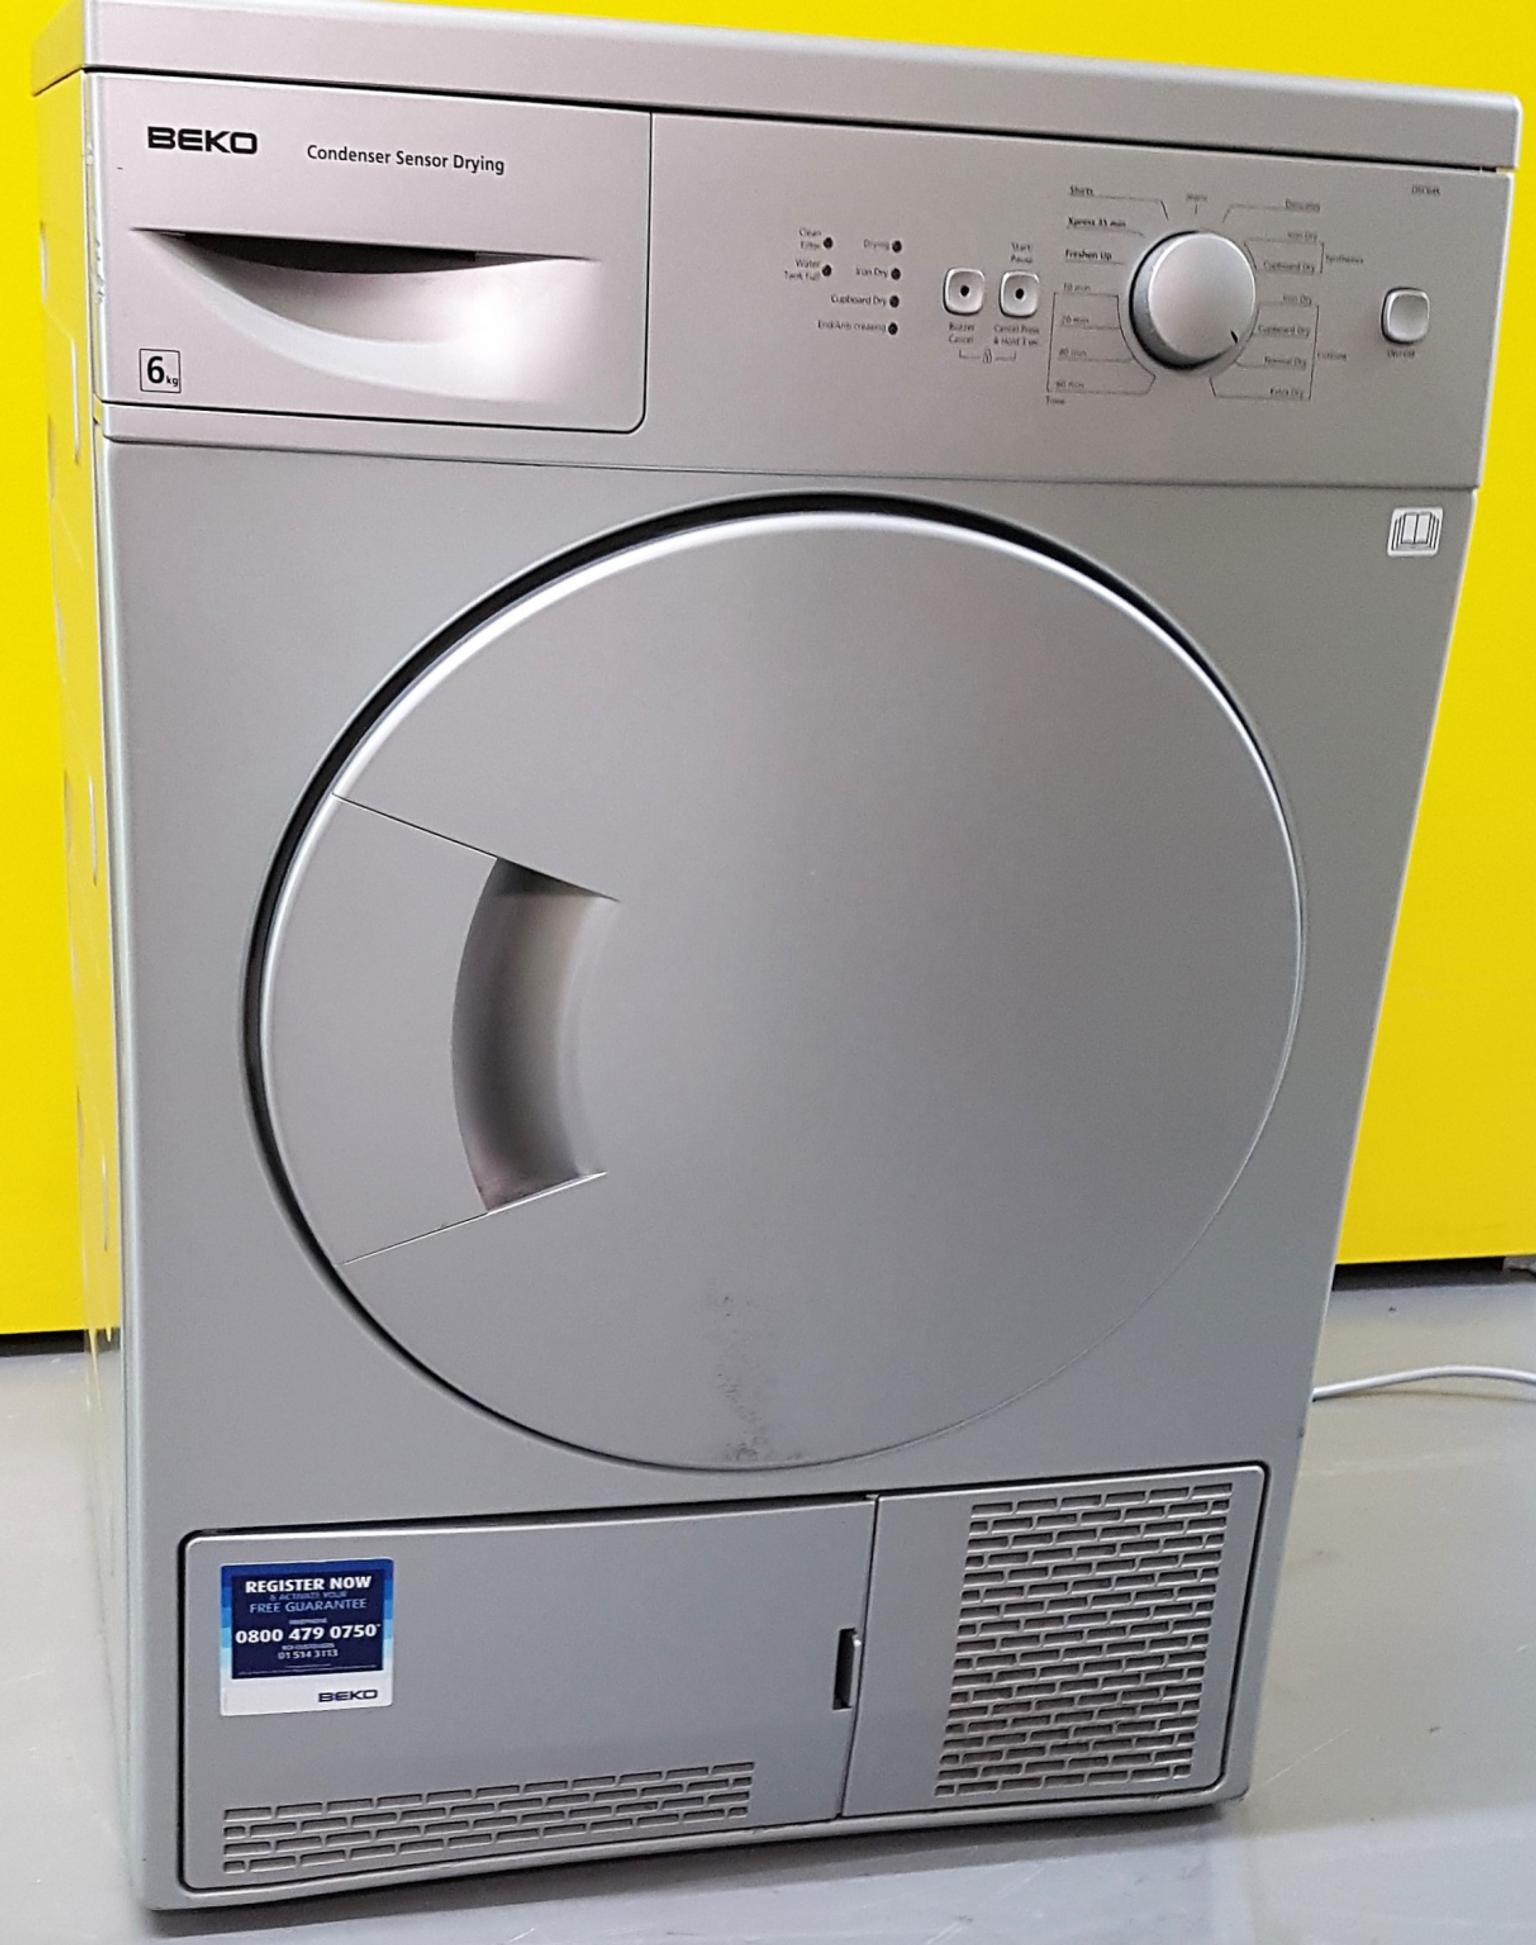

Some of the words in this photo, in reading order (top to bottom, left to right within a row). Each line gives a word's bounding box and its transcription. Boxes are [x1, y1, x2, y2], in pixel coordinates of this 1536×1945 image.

[147, 126, 258, 155] BEKO
[307, 144, 391, 164] Condenser
[396, 150, 449, 168] Sensor
[453, 154, 505, 176] Drying
[1064, 248, 1098, 260] Freshen
[1100, 250, 1112, 261] Up
[874, 267, 888, 279] Dry
[831, 294, 872, 305] Cupboard
[873, 295, 887, 307] Dry
[147, 356, 165, 384] 6
[166, 375, 179, 387] kg
[245, 1578, 325, 1593] REGISTER
[330, 1576, 372, 1590] NOW
[249, 1602, 281, 1614] FREE
[285, 1598, 367, 1613] GUARANTEE
[235, 1628, 284, 1644] 0800
[288, 1626, 325, 1641] 479
[318, 1689, 379, 1703] BEKO
